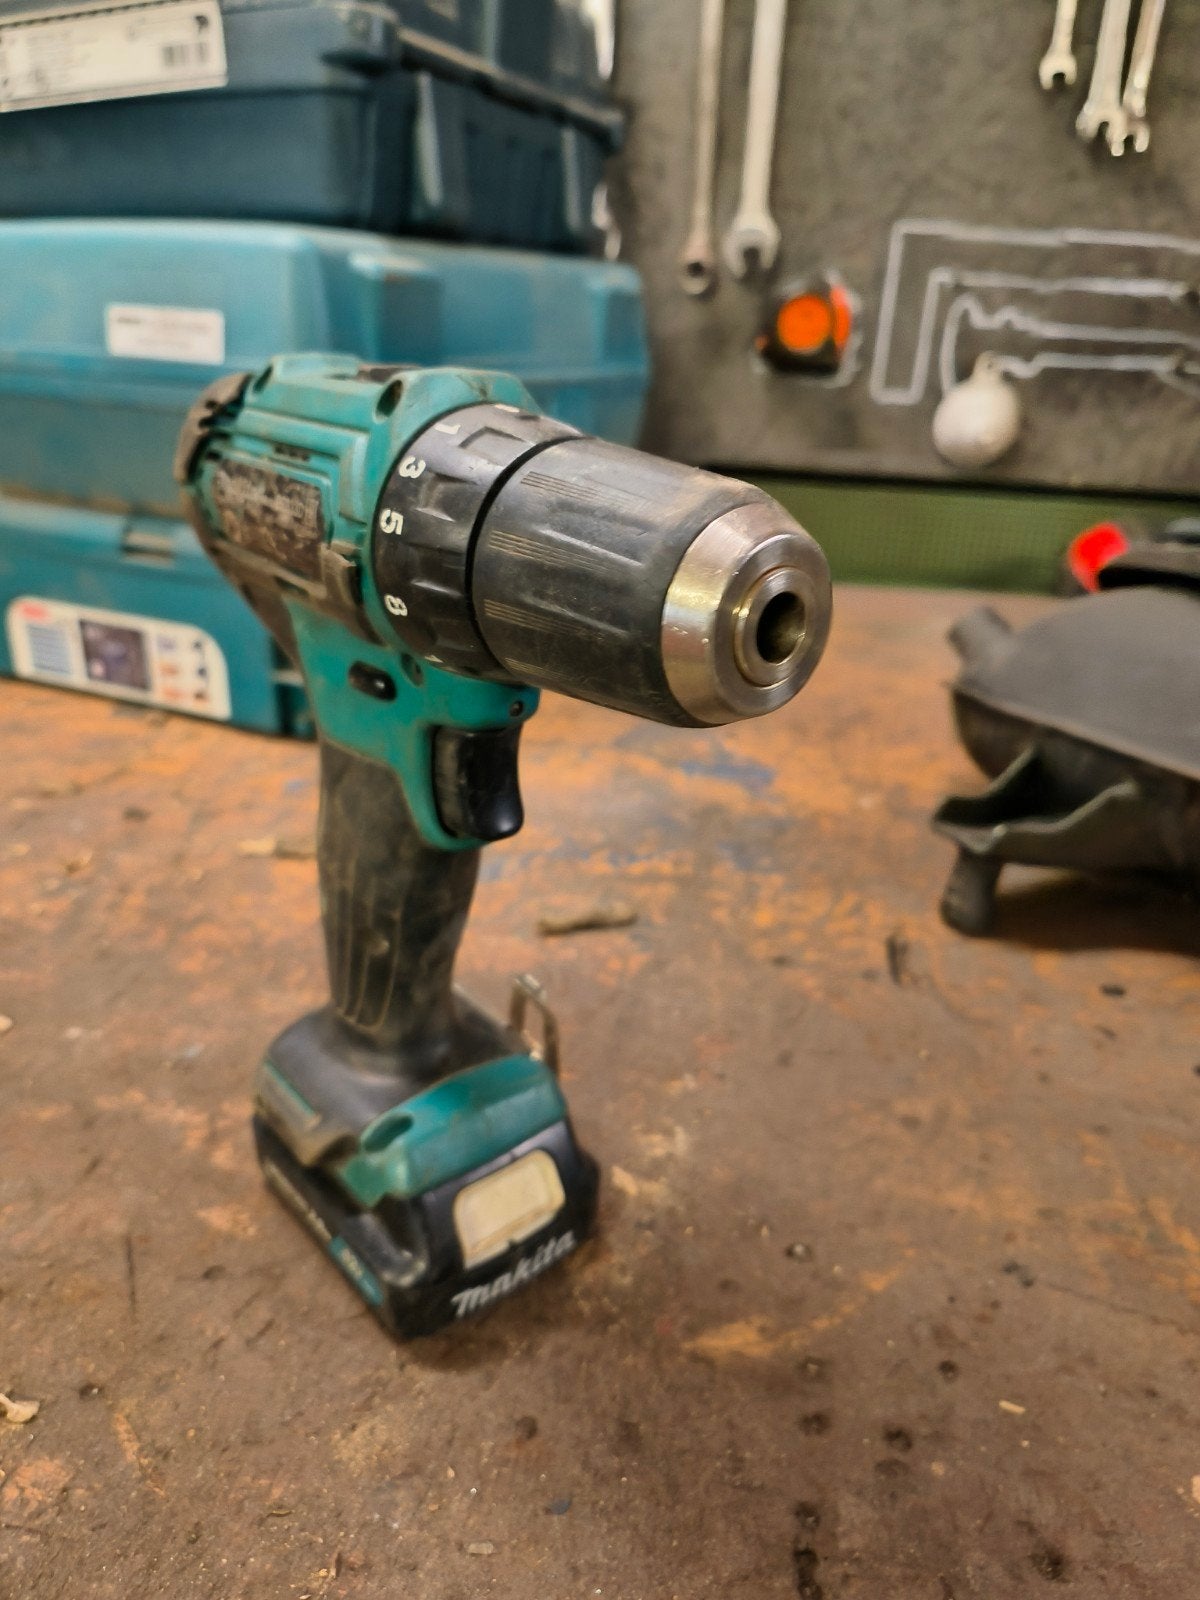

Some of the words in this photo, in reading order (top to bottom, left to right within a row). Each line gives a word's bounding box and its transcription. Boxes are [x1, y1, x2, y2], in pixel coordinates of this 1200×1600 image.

[399, 456, 426, 479] 3
[379, 509, 404, 535] 5
[384, 594, 408, 617] 8
[451, 1231, 577, 1318] makita
